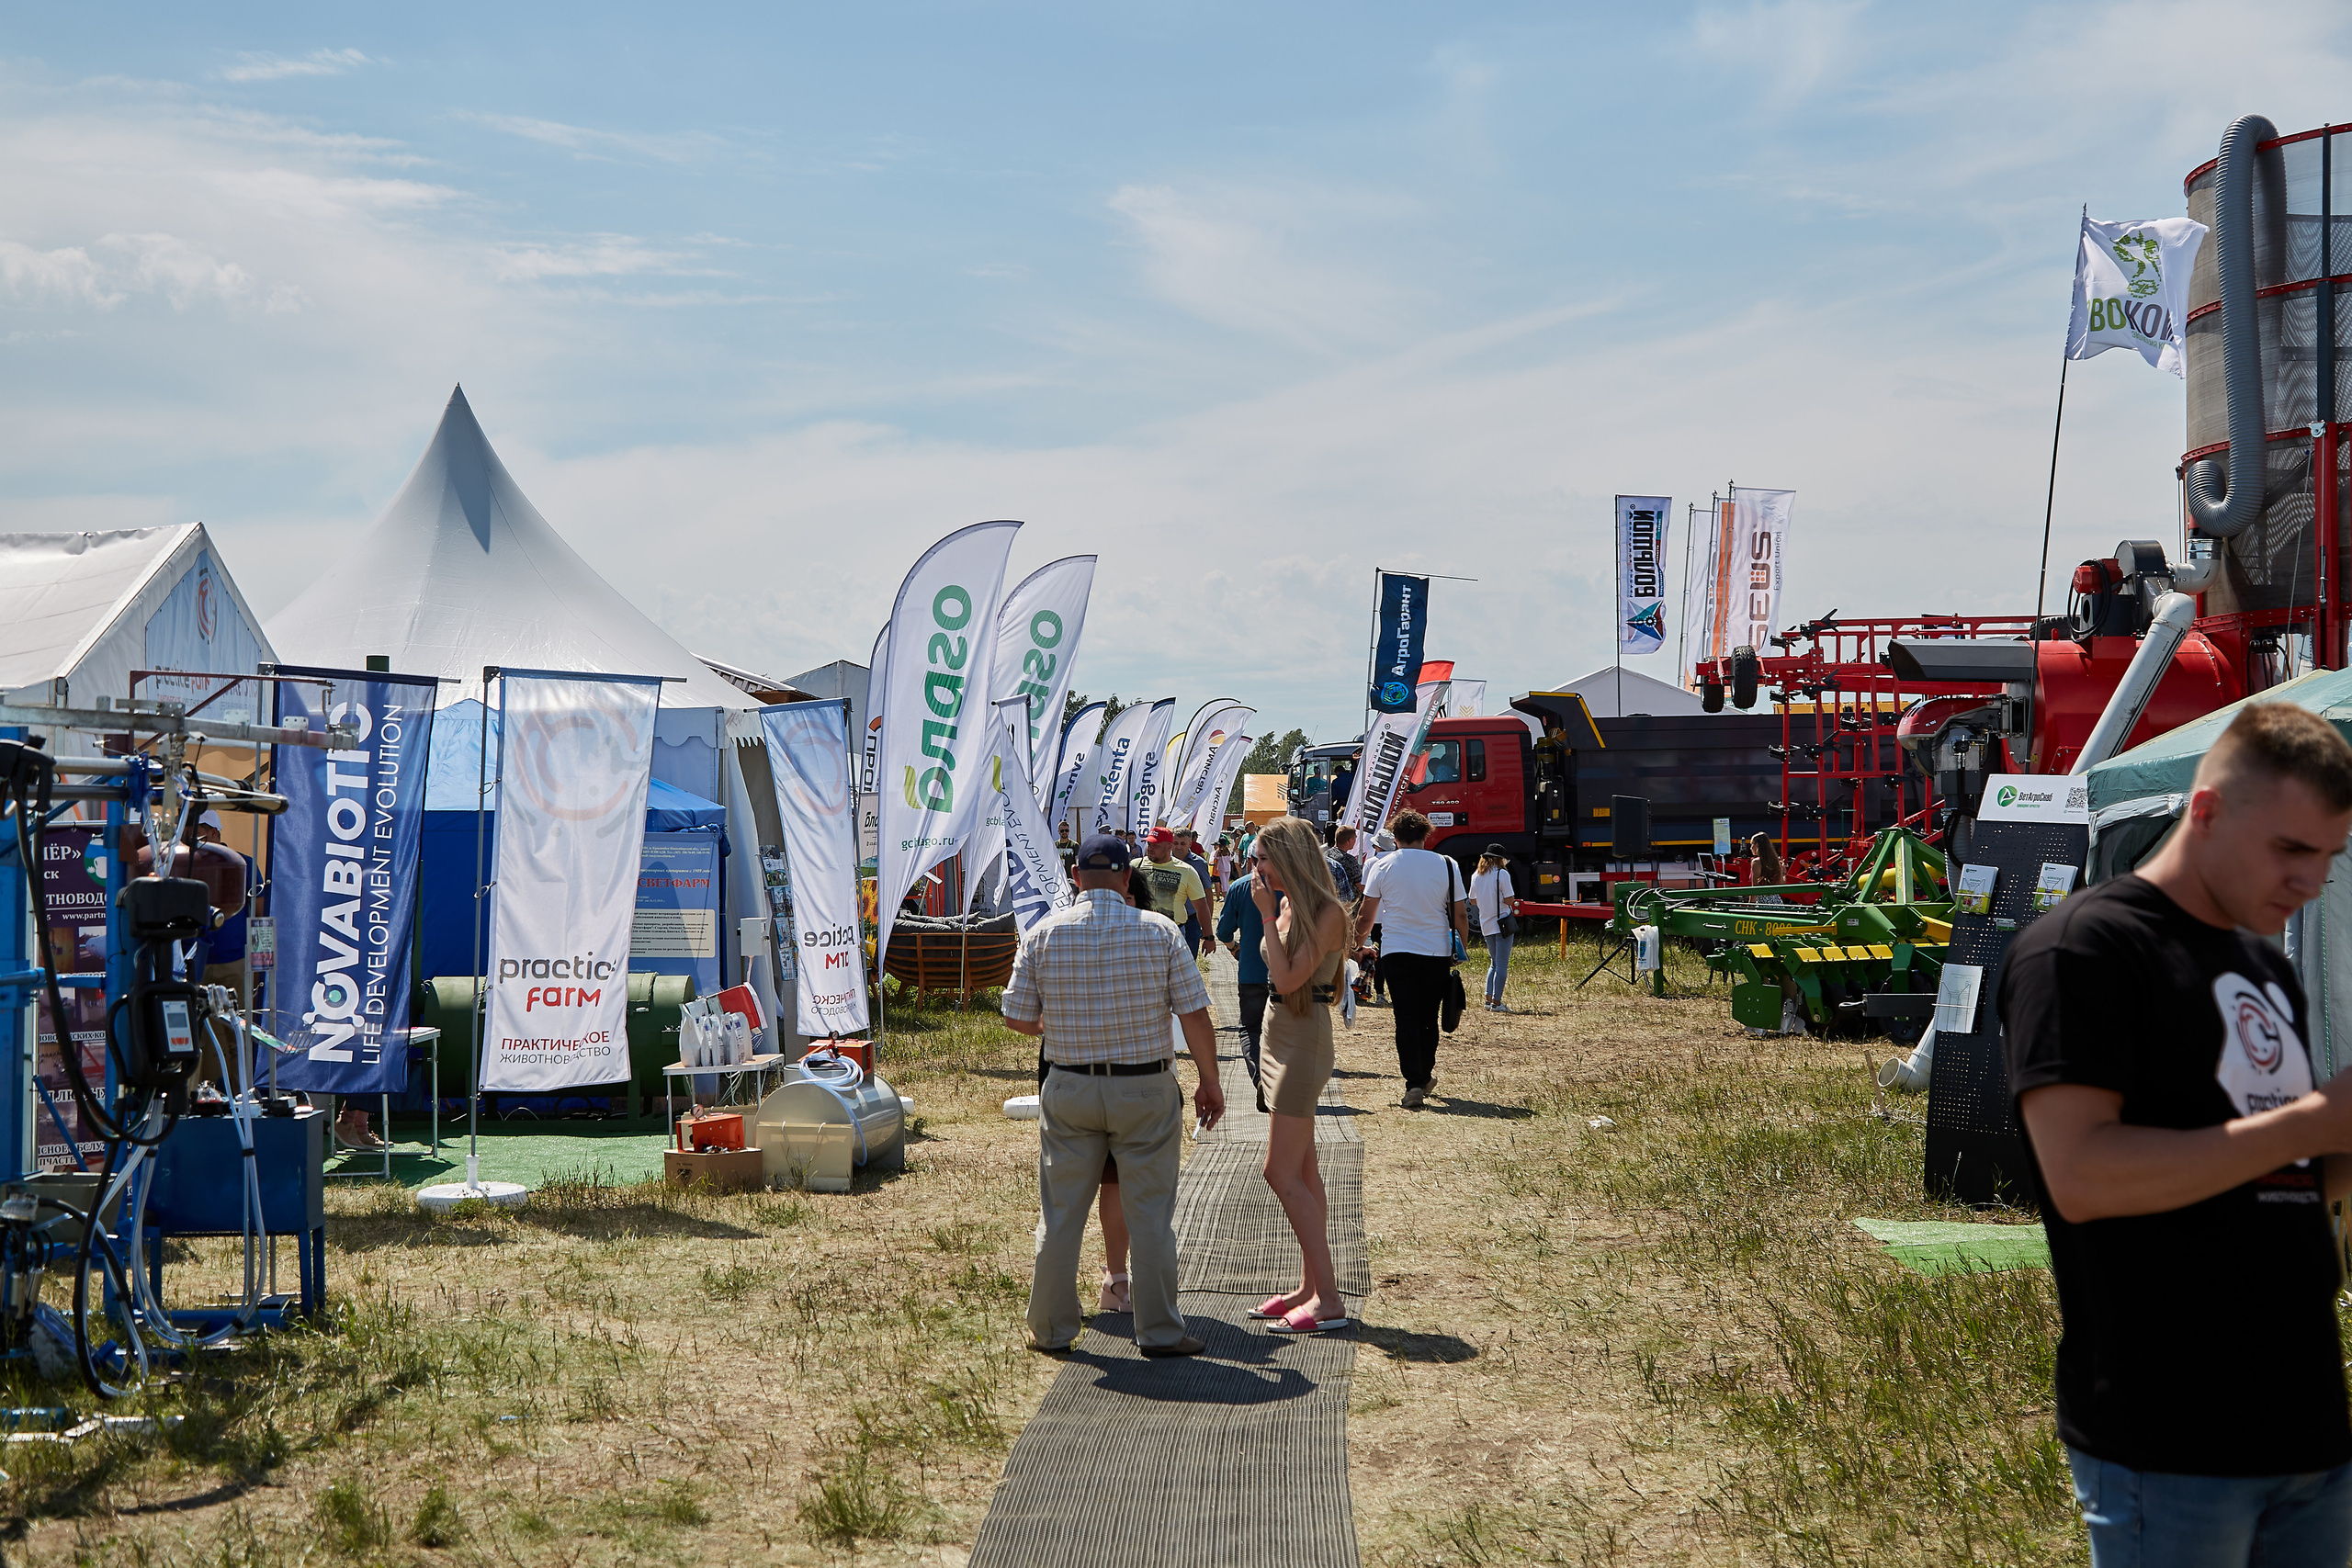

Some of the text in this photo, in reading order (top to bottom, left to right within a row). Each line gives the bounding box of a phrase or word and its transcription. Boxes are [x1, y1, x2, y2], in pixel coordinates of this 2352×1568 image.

[1629, 510, 1656, 597] БОЛЬШОЙ
[1773, 558, 1781, 591] Export
[1391, 584, 1412, 677] АгроГарант
[905, 585, 972, 814] благо
[62, 911, 107, 921] www.partn
[302, 701, 373, 1063] NOVABIOTIC
[361, 704, 403, 1064] LIFE DEVELOPMENT EVOLUTION
[638, 878, 710, 888] СВЕТФАРМ
